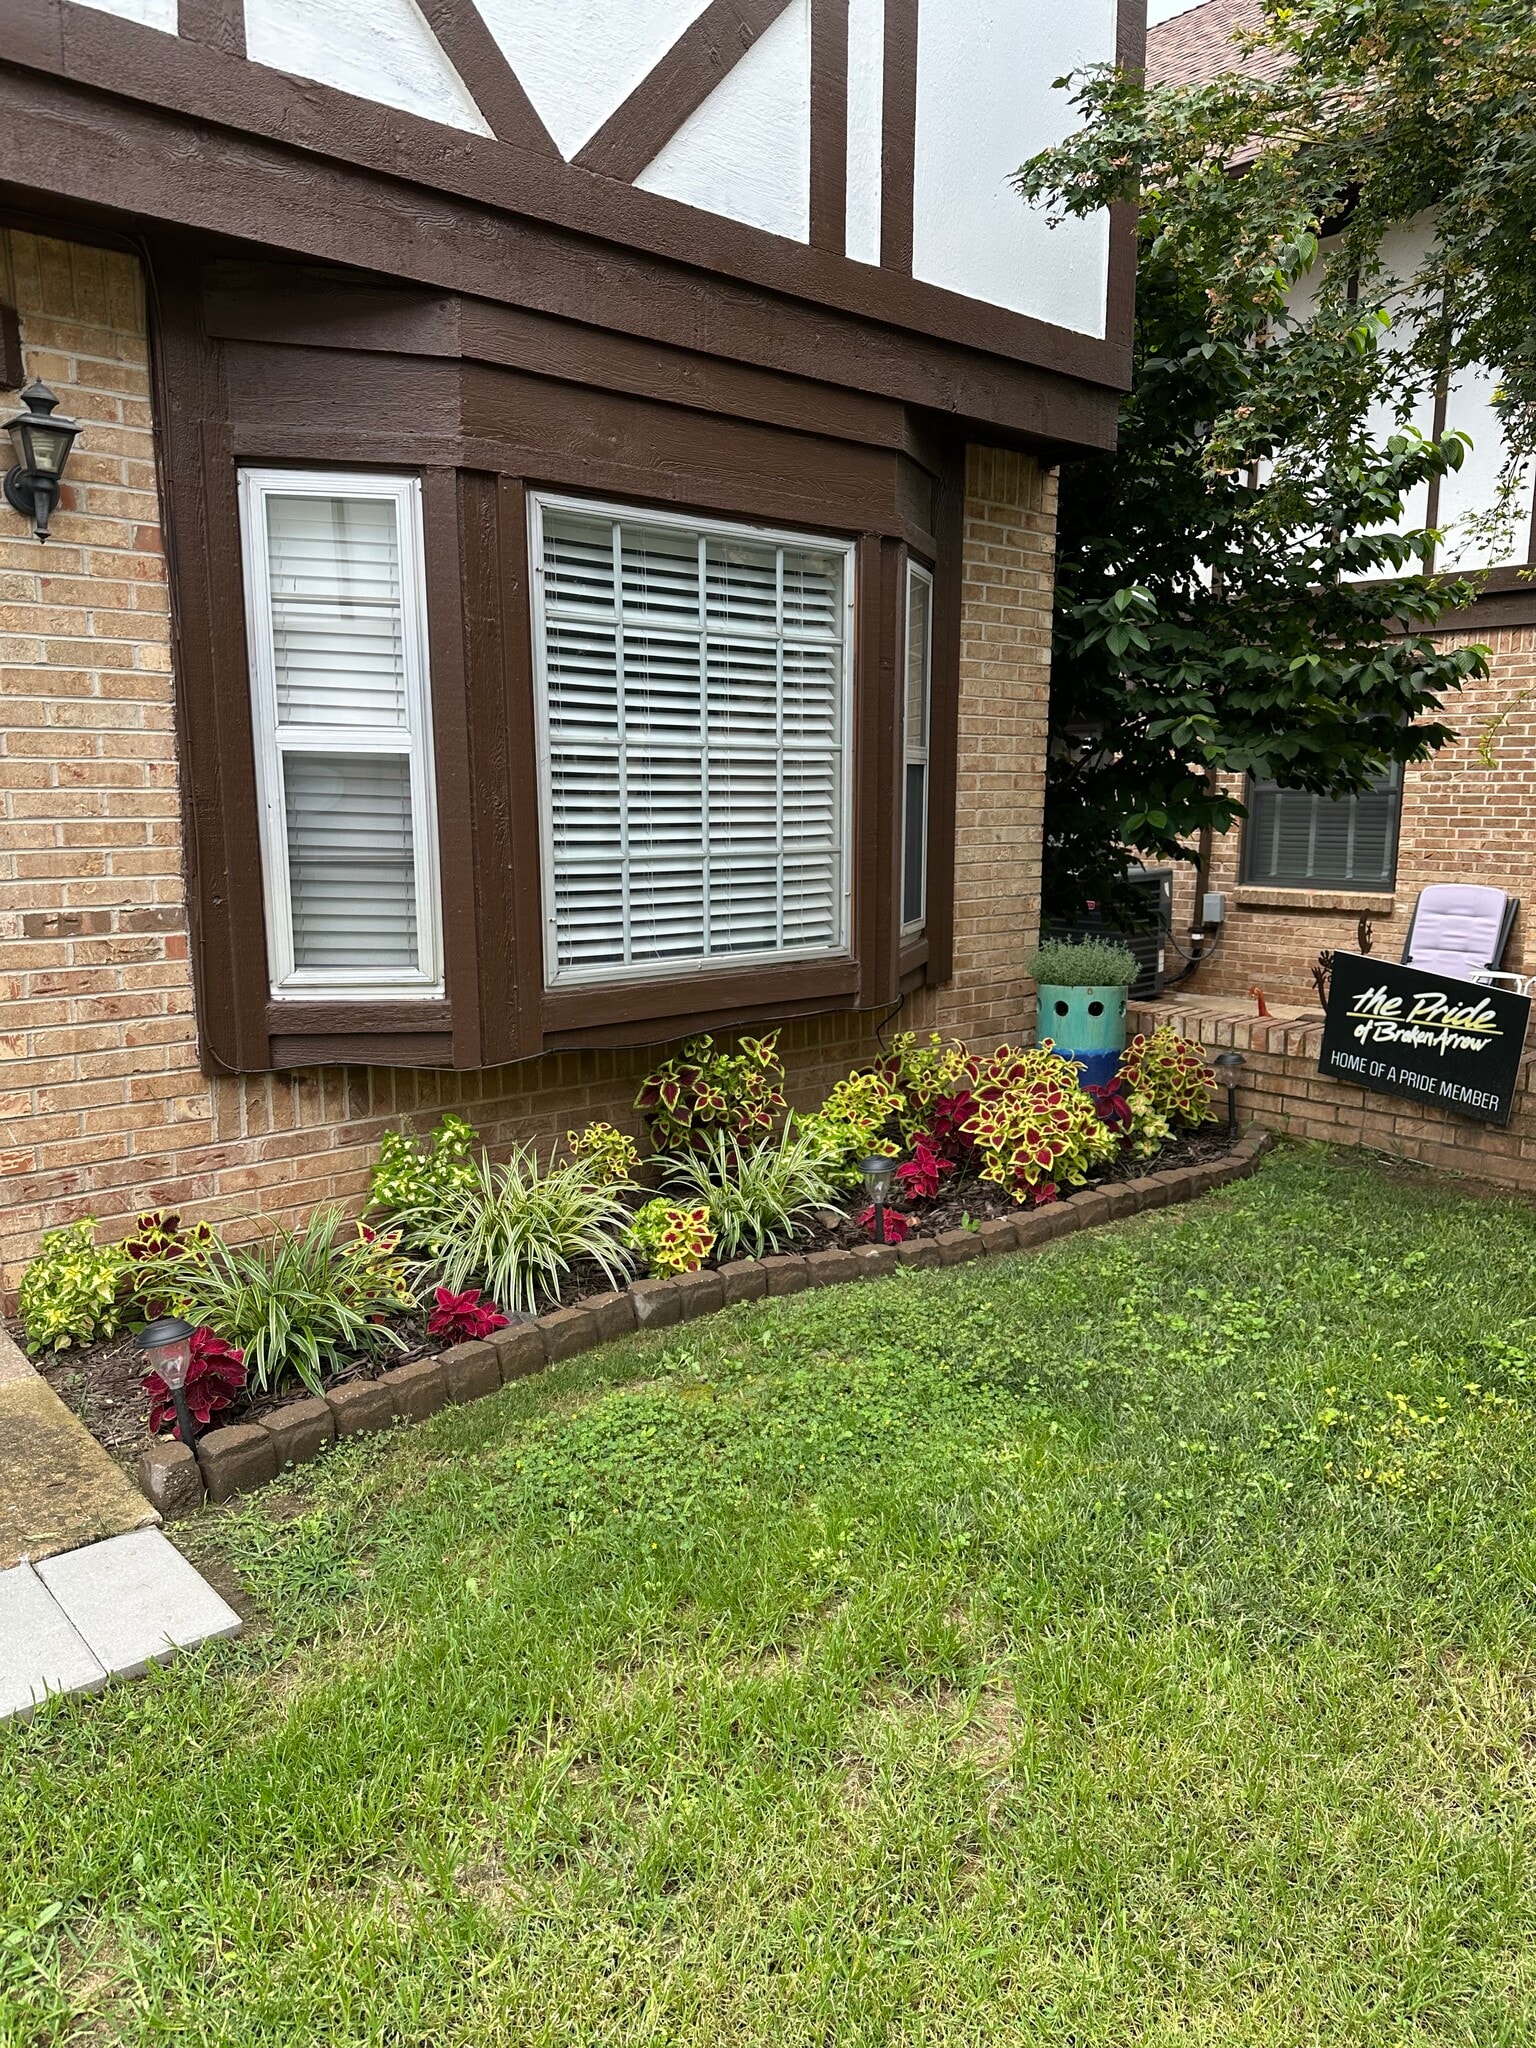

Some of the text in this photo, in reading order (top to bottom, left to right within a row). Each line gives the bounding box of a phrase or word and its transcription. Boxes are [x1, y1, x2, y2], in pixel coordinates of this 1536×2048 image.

[1352, 985, 1497, 1029] the Pride
[1353, 1020, 1374, 1045] of
[1330, 1050, 1500, 1112] HOME OF A PRIDE MEMBER
